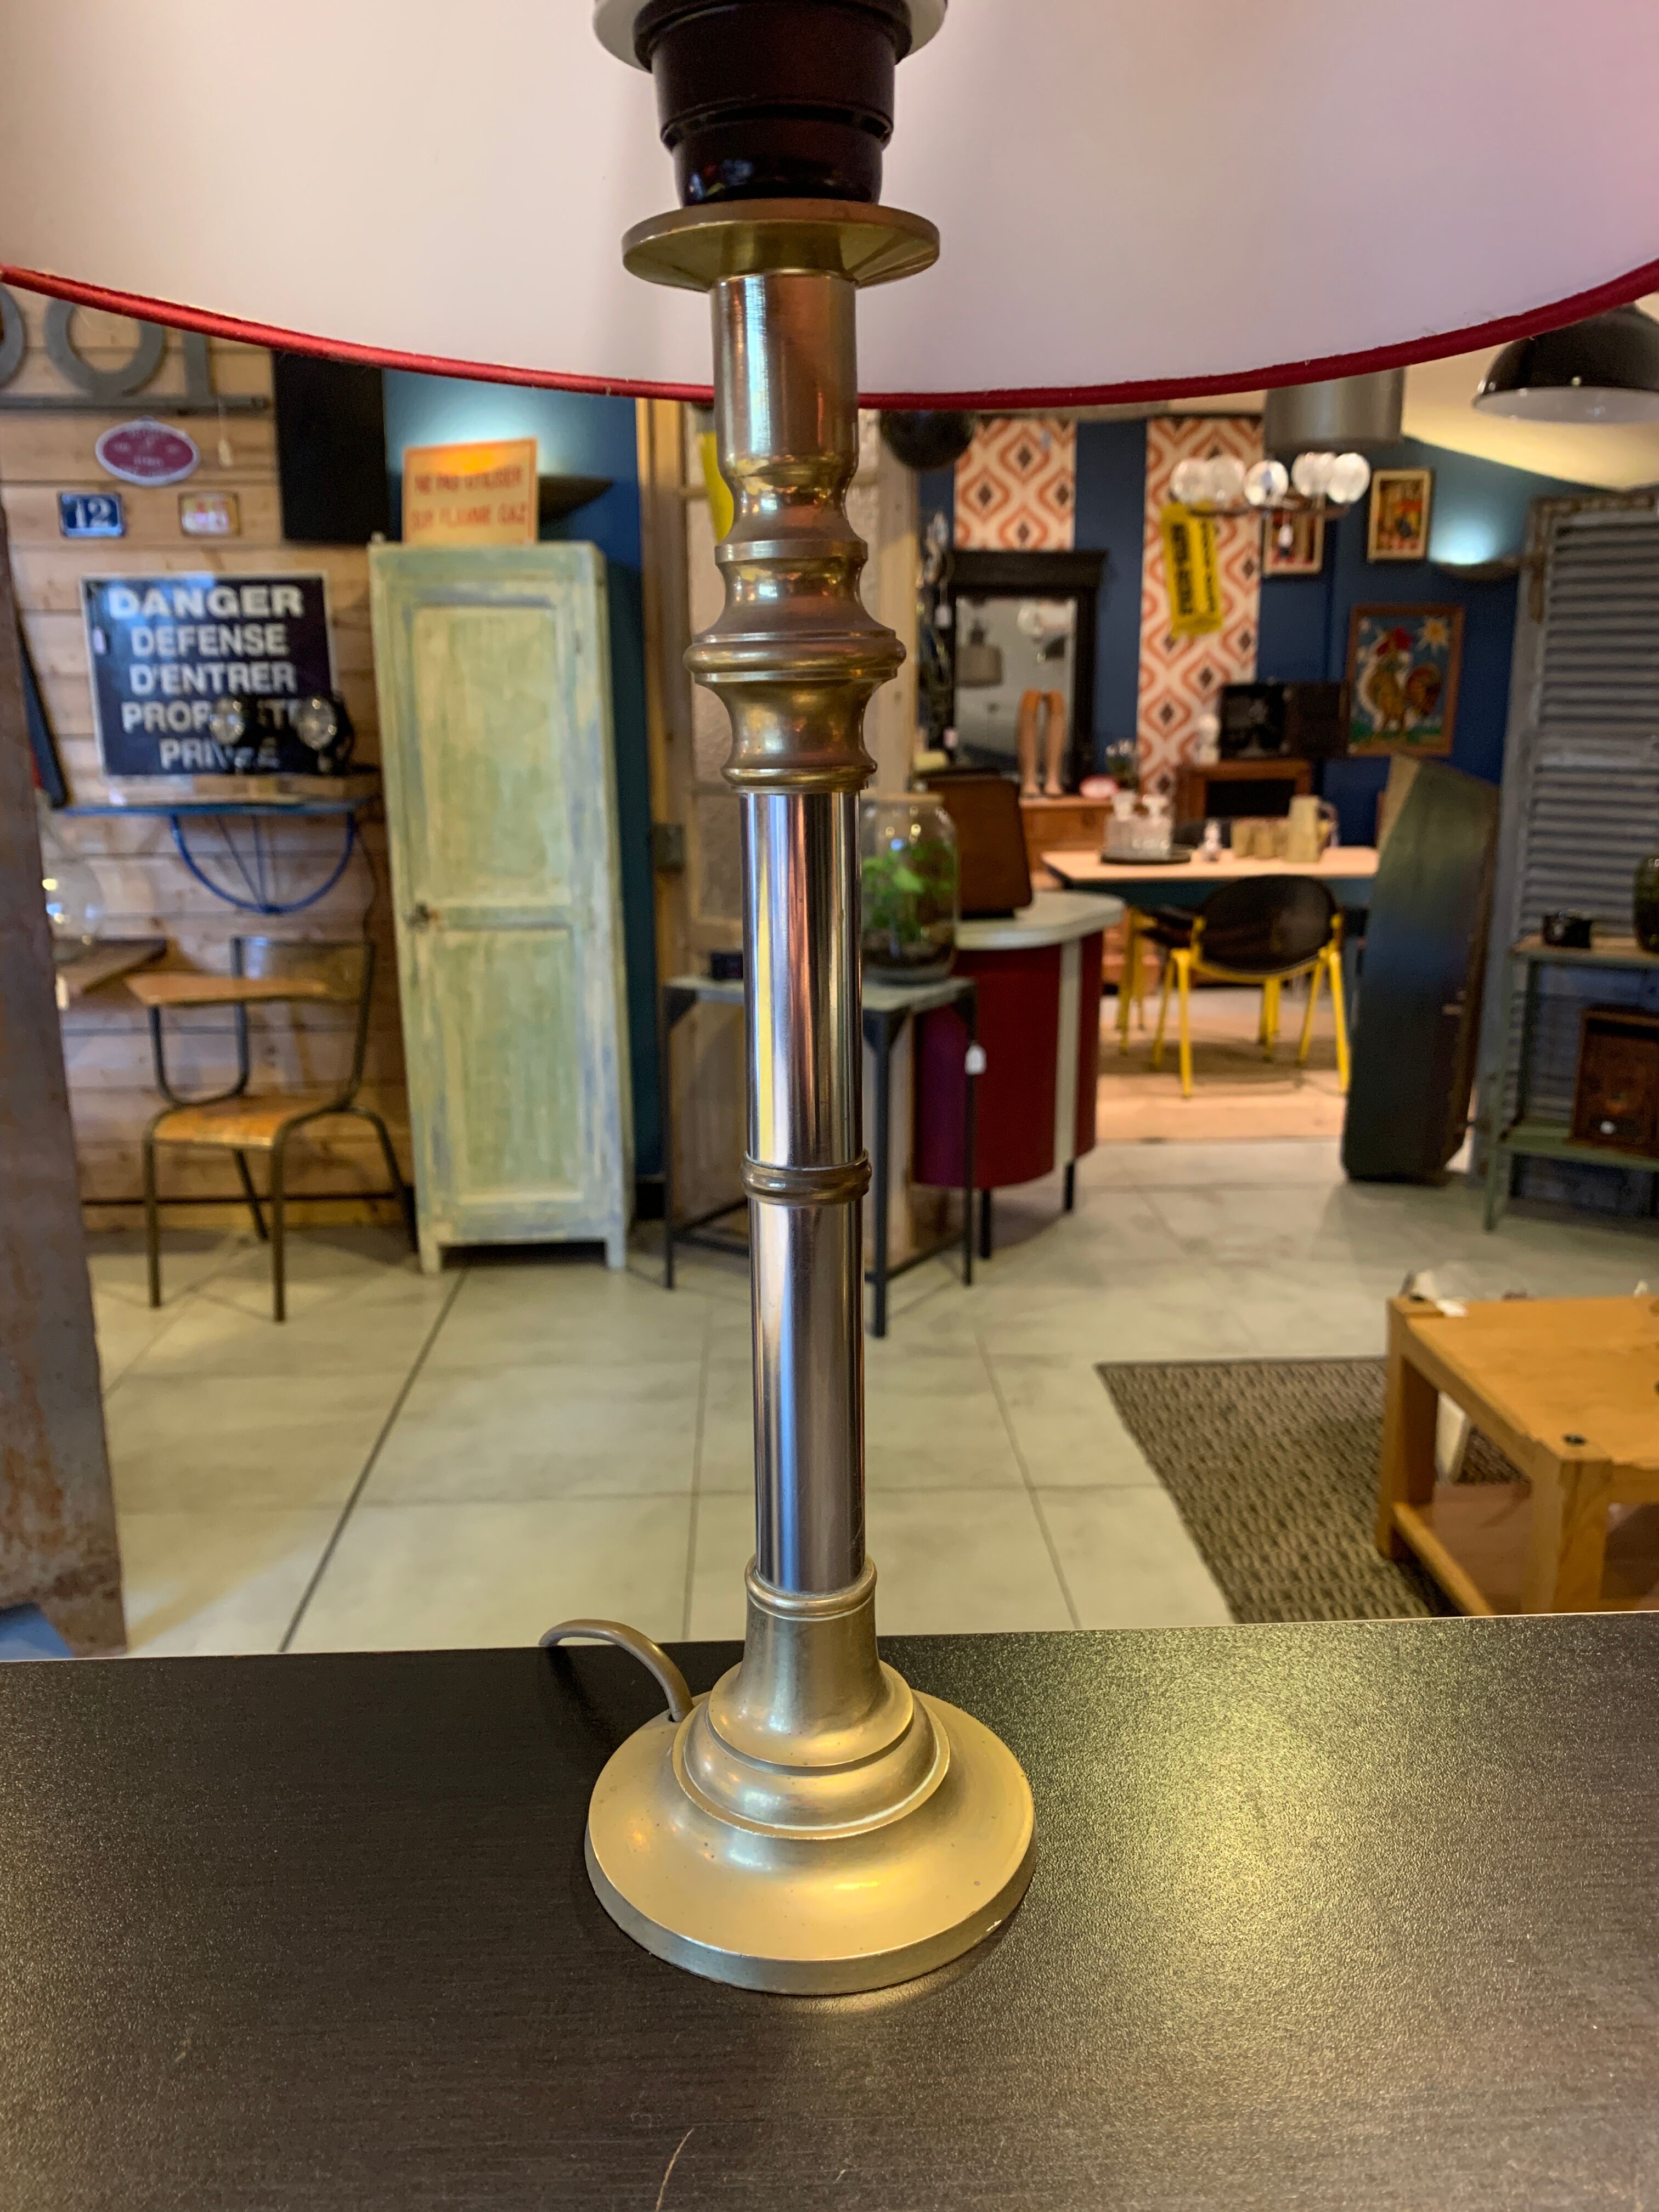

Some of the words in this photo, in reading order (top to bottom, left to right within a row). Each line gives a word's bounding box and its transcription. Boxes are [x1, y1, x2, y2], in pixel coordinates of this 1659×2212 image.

[75, 497, 110, 528] 12
[108, 584, 305, 619] DANGER
[131, 624, 290, 657] DEFENSE
[129, 661, 297, 695] D'ENTRER
